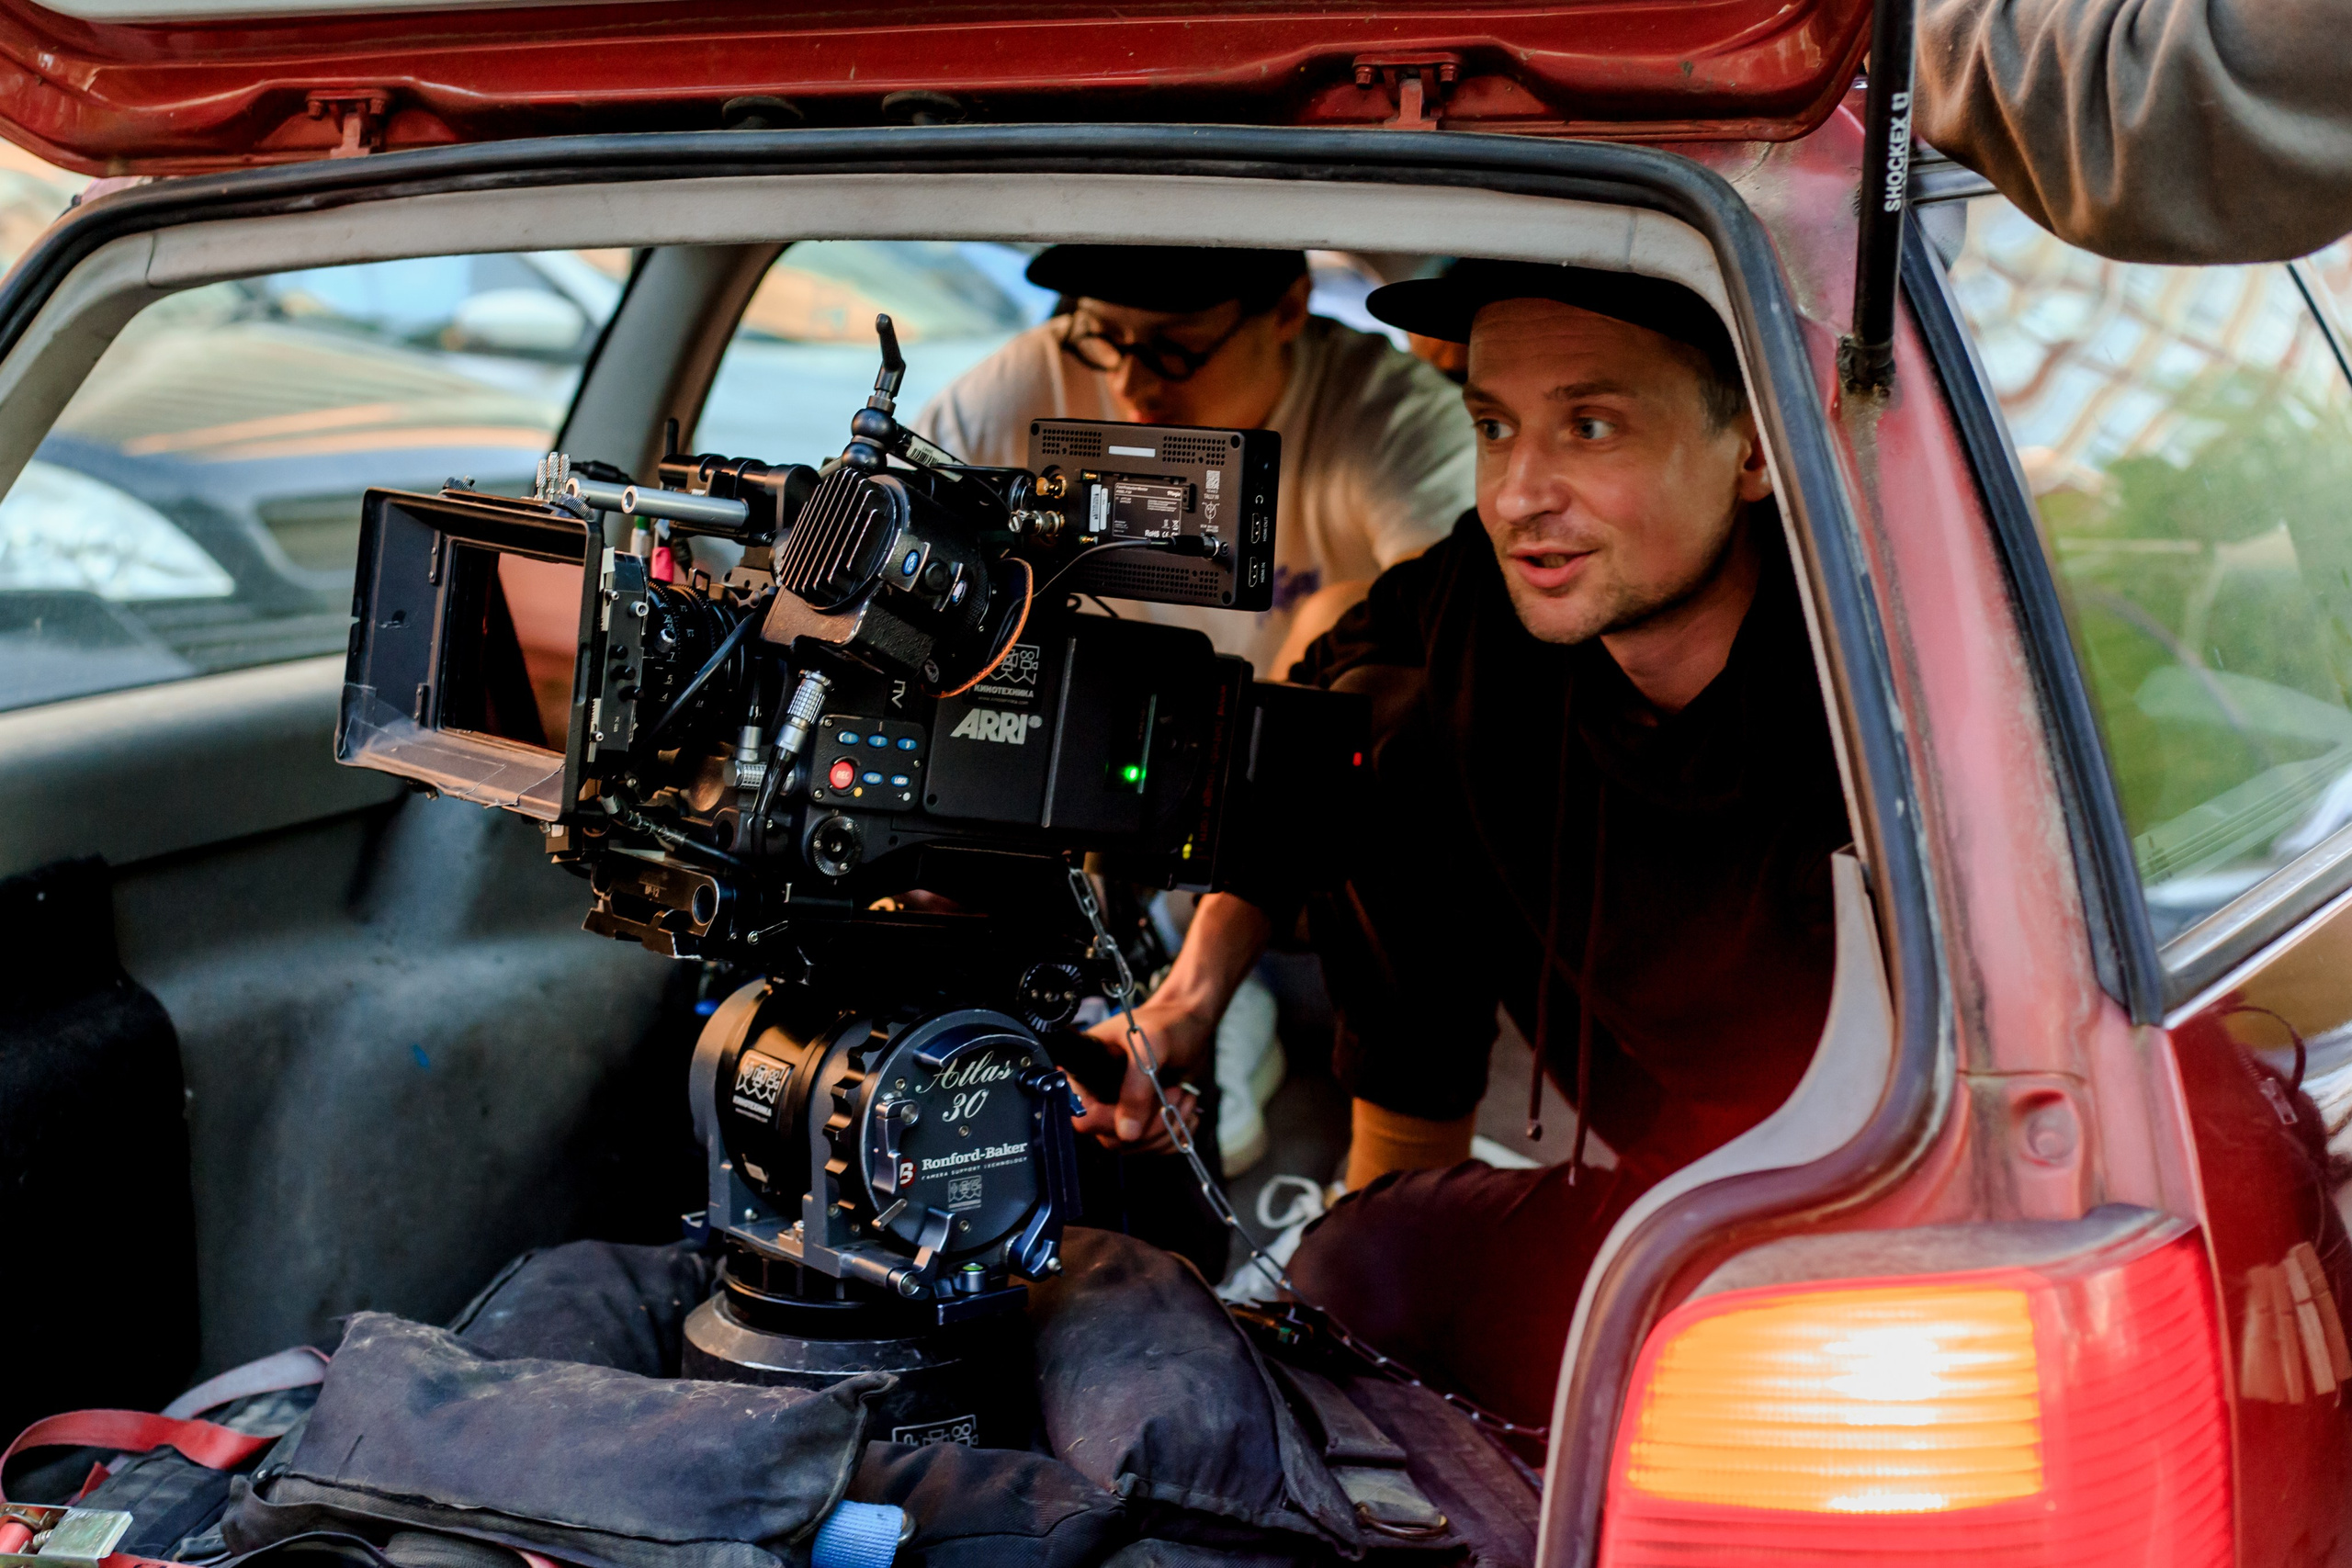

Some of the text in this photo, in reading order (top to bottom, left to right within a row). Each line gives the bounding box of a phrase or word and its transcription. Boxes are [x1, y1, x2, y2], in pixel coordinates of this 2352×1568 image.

[1884, 116, 1909, 212] SHOCKEX
[974, 684, 1034, 698] КИНОТЕХНИКА
[949, 707, 1028, 745] ARRI
[836, 770, 851, 780] REC
[914, 1050, 1014, 1094] Atlas
[942, 1089, 990, 1122] 30
[921, 1156, 1028, 1181] CAMERA SUPPORT TECHNOLOGY
[922, 1142, 1029, 1171] Ronford-Baker
